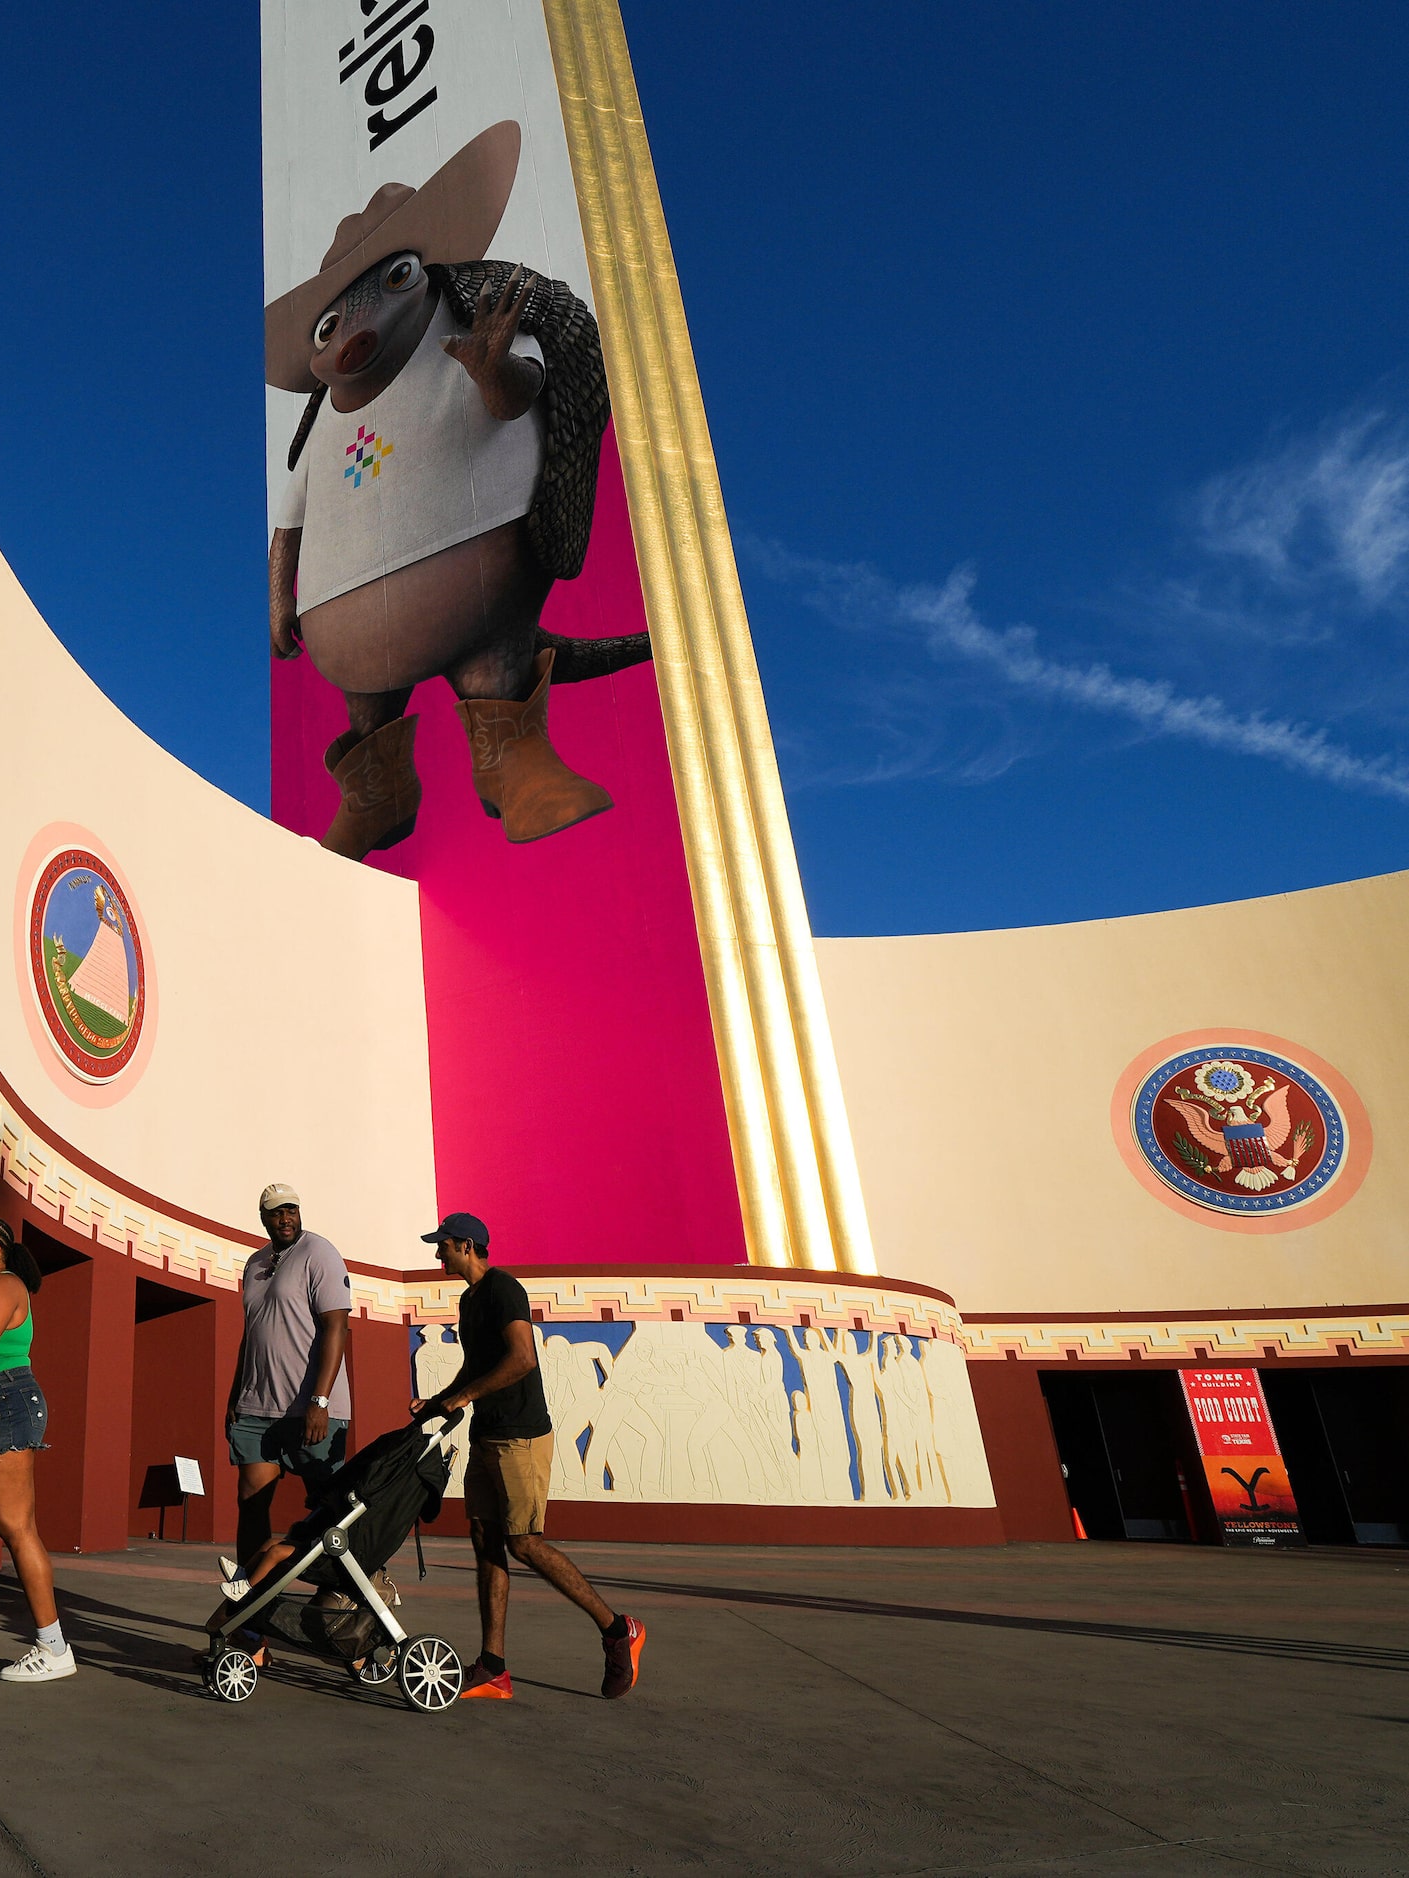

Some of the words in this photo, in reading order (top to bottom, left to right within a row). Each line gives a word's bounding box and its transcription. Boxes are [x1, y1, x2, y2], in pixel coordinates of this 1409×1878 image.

[338, 0, 438, 153] reli
[1194, 1373, 1243, 1381] TOWER
[1193, 1397, 1224, 1422] FOOD
[1223, 1397, 1262, 1422] COURT
[1224, 1521, 1298, 1529] YELLOWSTONE
[332, 1535, 341, 1545] b
